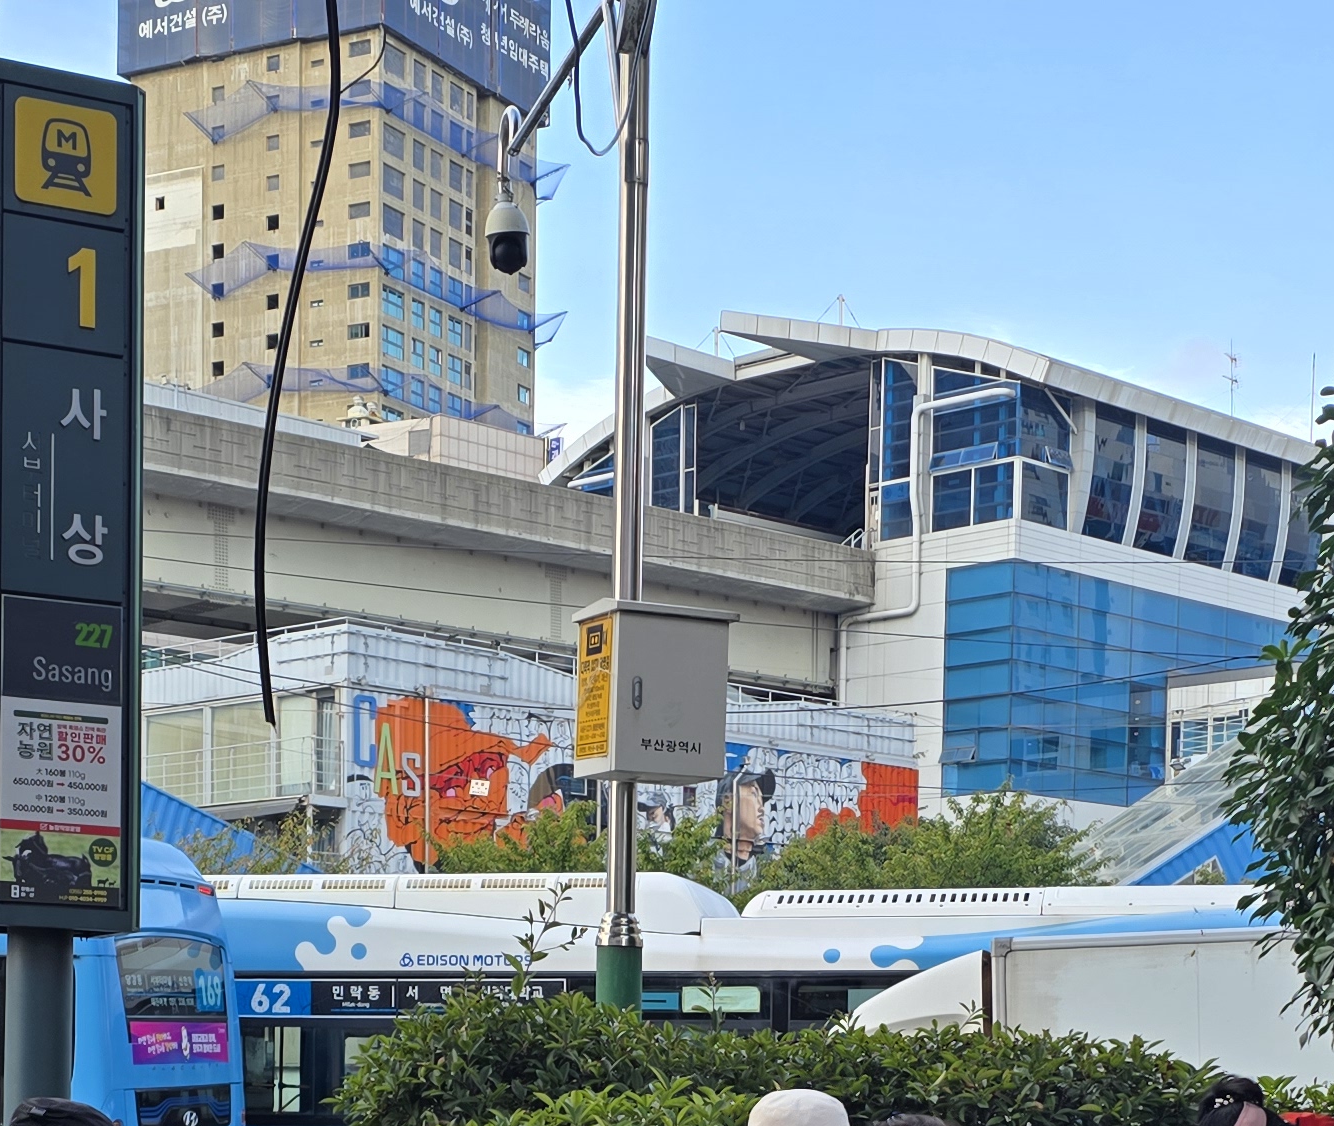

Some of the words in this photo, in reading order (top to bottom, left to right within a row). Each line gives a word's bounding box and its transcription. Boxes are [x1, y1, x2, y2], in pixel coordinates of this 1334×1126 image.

[138, 7, 196, 38] 예서건설
[202, 3, 227, 27] (주)
[457, 22, 473, 49] (주)
[67, 247, 97, 329] 1
[60, 388, 109, 566] 사상
[74, 622, 113, 649] 227
[32, 656, 112, 692] Sasang
[17, 721, 54, 741] 자연
[57, 730, 107, 746] 할인판매
[17, 740, 54, 761] 농원
[57, 743, 106, 765] 30%
[640, 737, 702, 755] 부산광역시
[416, 954, 470, 967] EDISON
[198, 974, 222, 1007] 169
[250, 983, 292, 1013] 62
[331, 985, 381, 1001] 민락동
